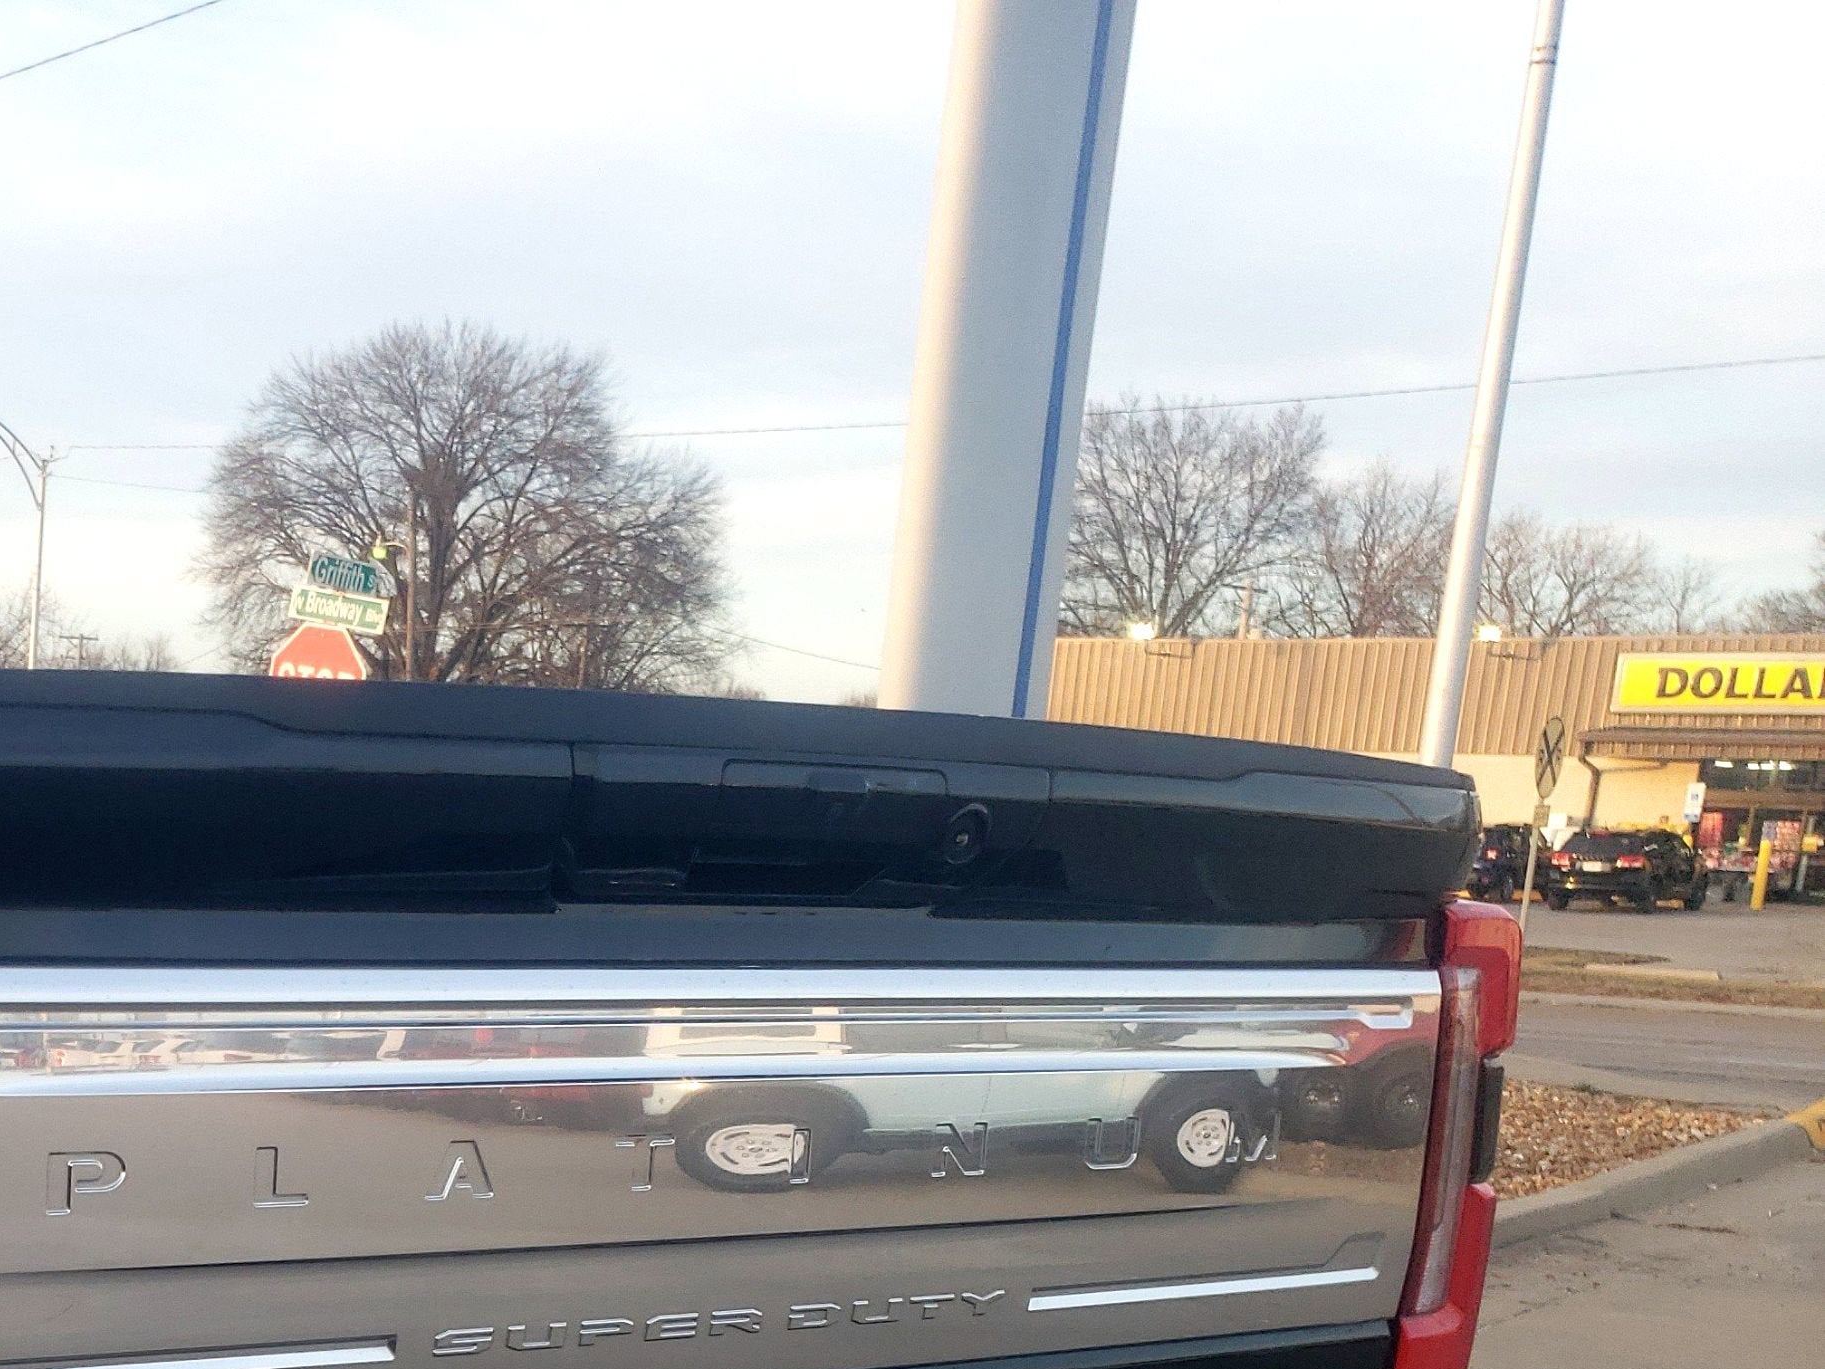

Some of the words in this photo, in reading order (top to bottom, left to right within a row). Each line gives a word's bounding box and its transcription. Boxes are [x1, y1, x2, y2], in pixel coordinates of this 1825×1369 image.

[314, 557, 365, 593] Griffith
[305, 591, 364, 626] Broadway
[1656, 667, 1825, 699] DOLLA
[45, 1110, 1281, 1216] PLATINUM
[432, 1308, 763, 1356] SUPER
[787, 1289, 1006, 1331] DUTY
